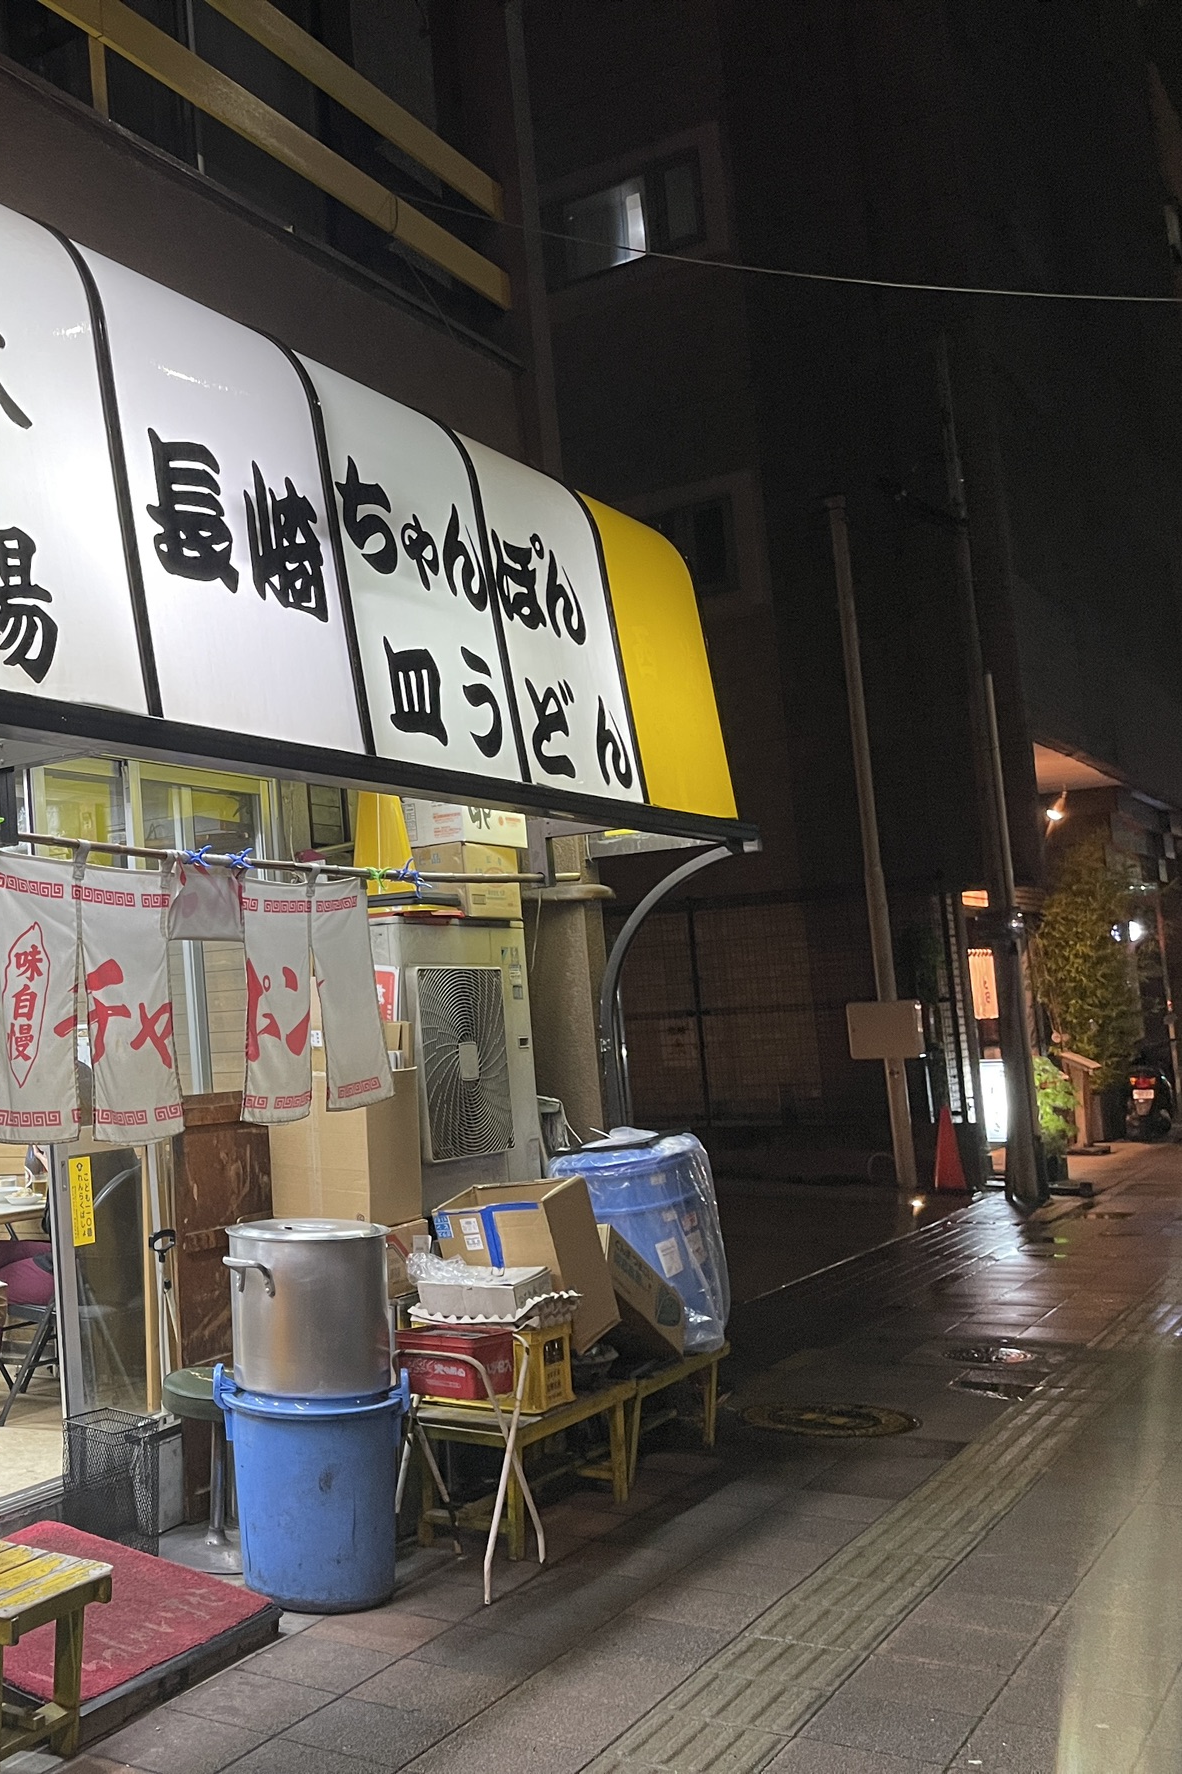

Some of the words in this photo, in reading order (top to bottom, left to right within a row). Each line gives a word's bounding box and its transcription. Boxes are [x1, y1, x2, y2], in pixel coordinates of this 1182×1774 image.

[382, 635, 635, 791] 皿うどん
[7, 943, 45, 1064] 味自慢
